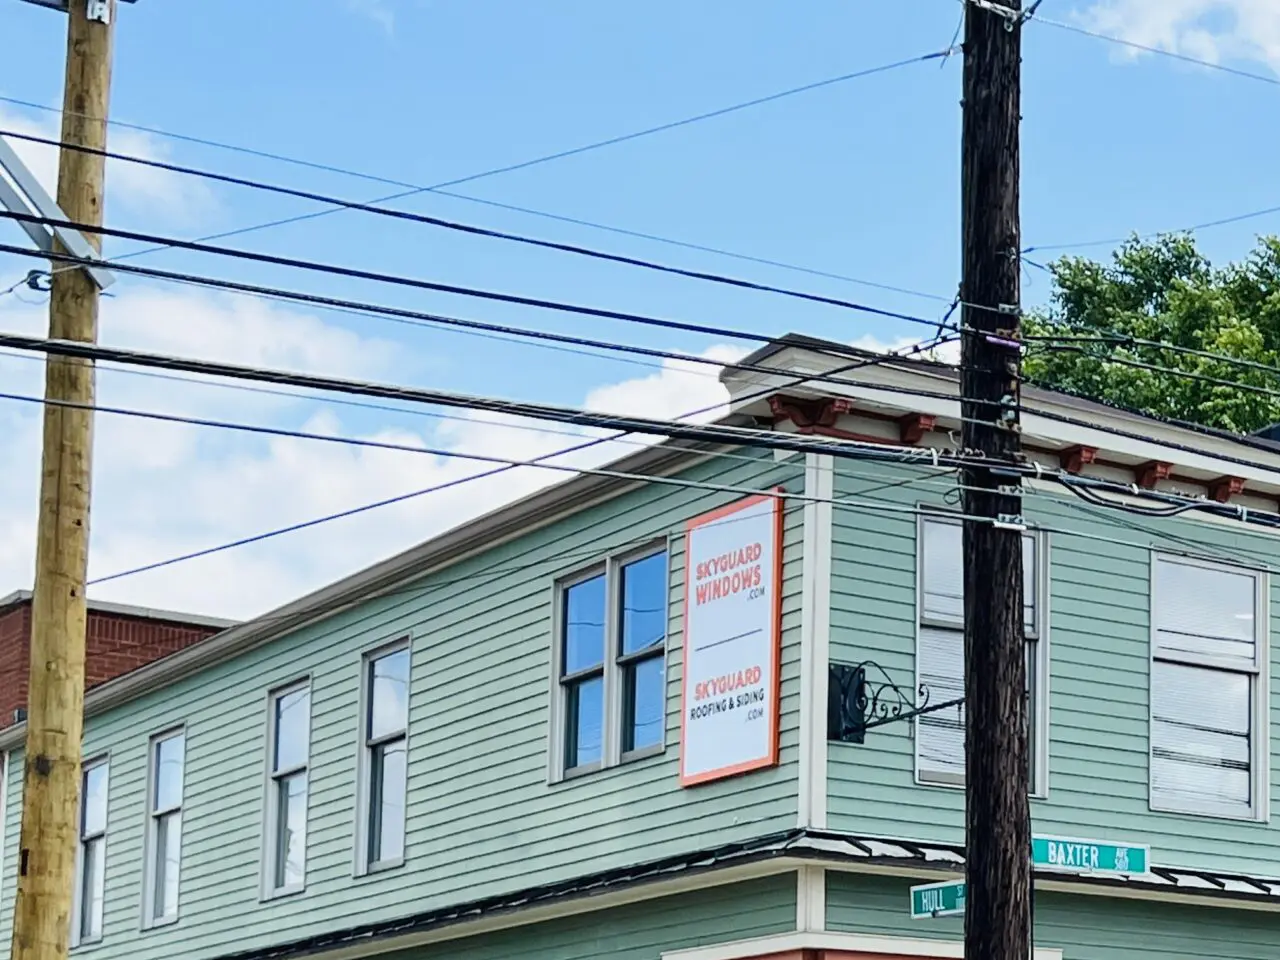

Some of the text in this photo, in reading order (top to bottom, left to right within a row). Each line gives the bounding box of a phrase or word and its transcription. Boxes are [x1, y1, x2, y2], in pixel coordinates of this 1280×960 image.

[696, 543, 762, 580] SKYGUARD
[696, 564, 761, 606] WINDOWS
[747, 586, 765, 601] .COM
[695, 665, 762, 700] SKYGUARD
[690, 687, 765, 720] ROOFING & SIDING
[1048, 841, 1099, 869] BAXTER
[921, 889, 946, 912] HULL
